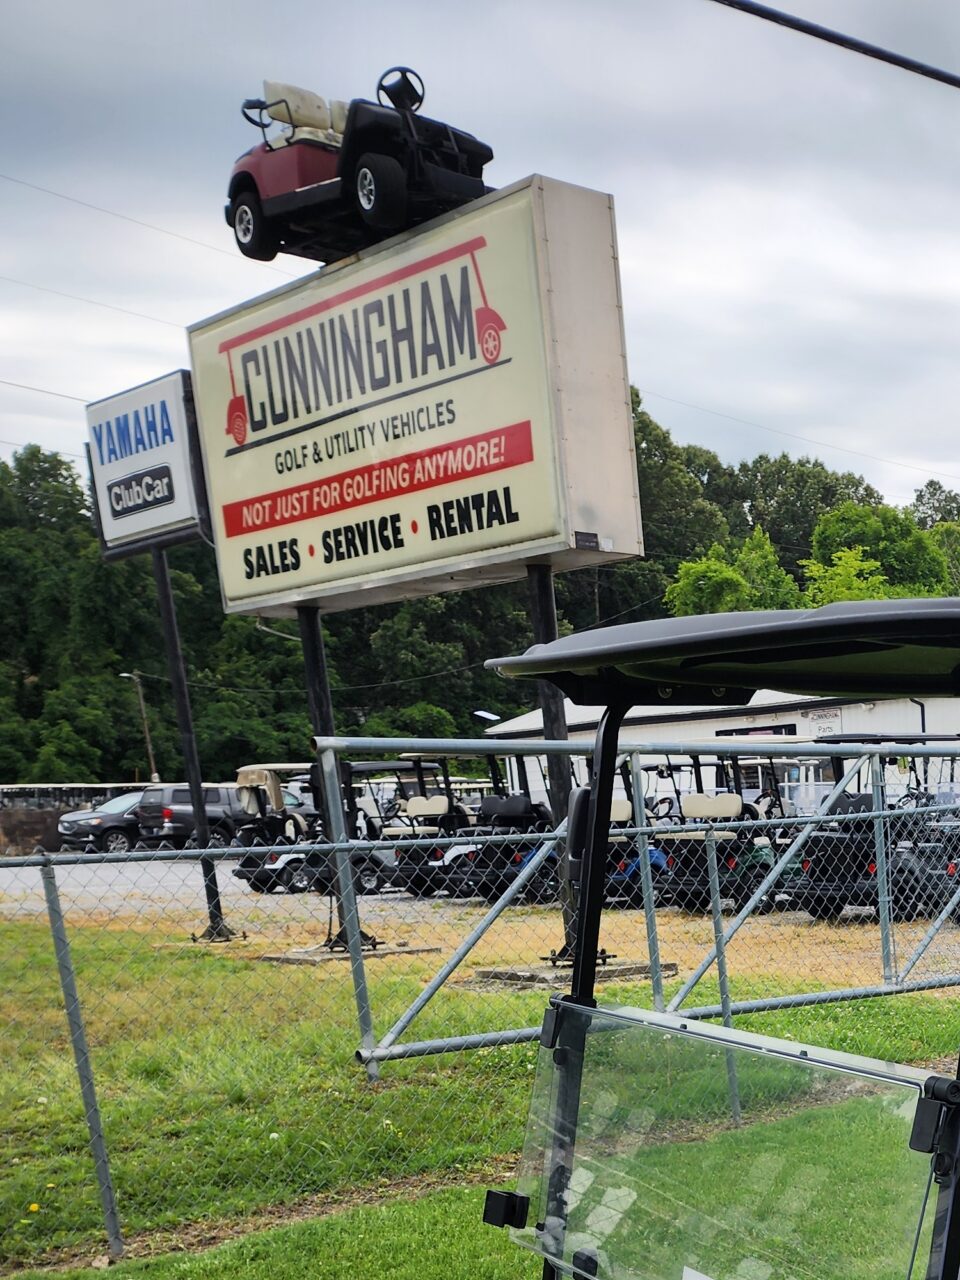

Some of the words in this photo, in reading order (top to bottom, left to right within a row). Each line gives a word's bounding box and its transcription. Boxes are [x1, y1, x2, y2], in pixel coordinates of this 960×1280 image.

[241, 265, 477, 432] CUNNINGHAM
[92, 400, 175, 466] YAMAHA
[274, 441, 309, 475] GOLF
[312, 444, 324, 464] &
[324, 419, 379, 460] UTILITY
[379, 398, 457, 442] VEHICLES
[111, 476, 170, 511] ClubCar
[242, 500, 272, 529] NOT
[273, 490, 310, 521] JUST
[312, 482, 341, 512] FOR
[343, 461, 410, 503] GOLFING
[413, 435, 506, 485] ANYMORE!
[243, 537, 301, 580] SALES
[321, 512, 406, 565] SERVICE
[426, 485, 520, 542] RENTAL
